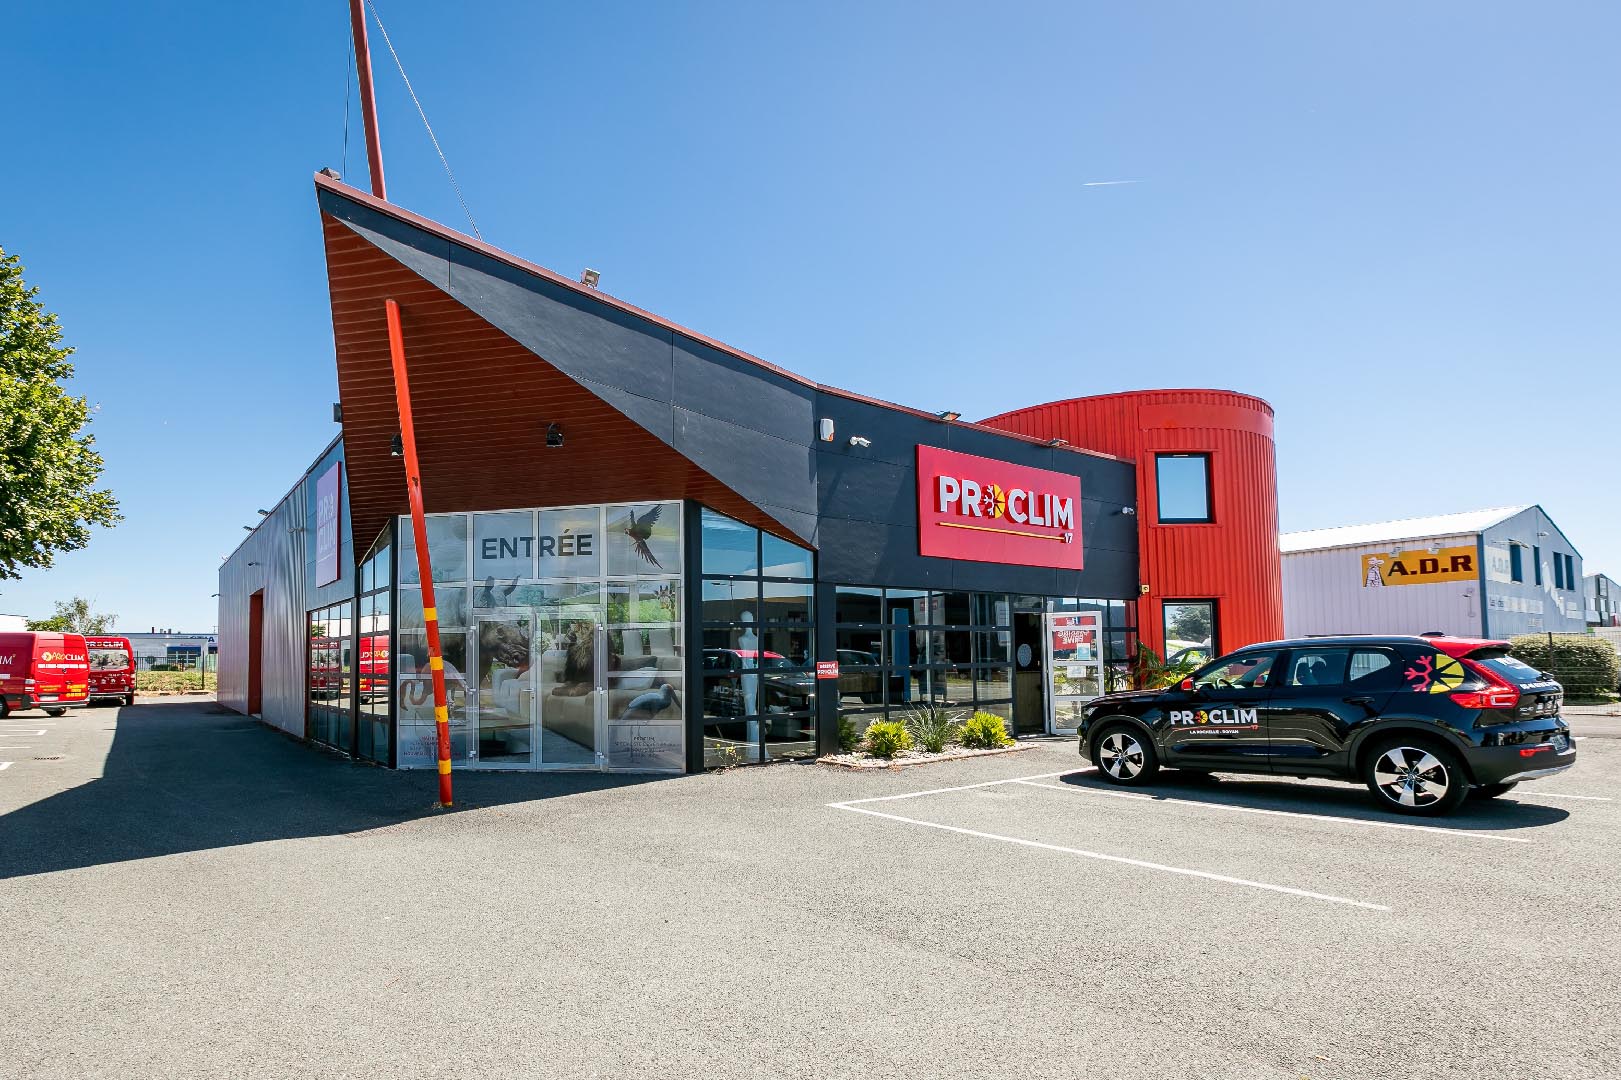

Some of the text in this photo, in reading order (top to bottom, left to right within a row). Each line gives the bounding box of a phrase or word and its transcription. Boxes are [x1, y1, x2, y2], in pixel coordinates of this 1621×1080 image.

[481, 528, 593, 560] ENTRÉE
[1064, 532, 1073, 544] 17
[1387, 554, 1473, 577] A.D.R
